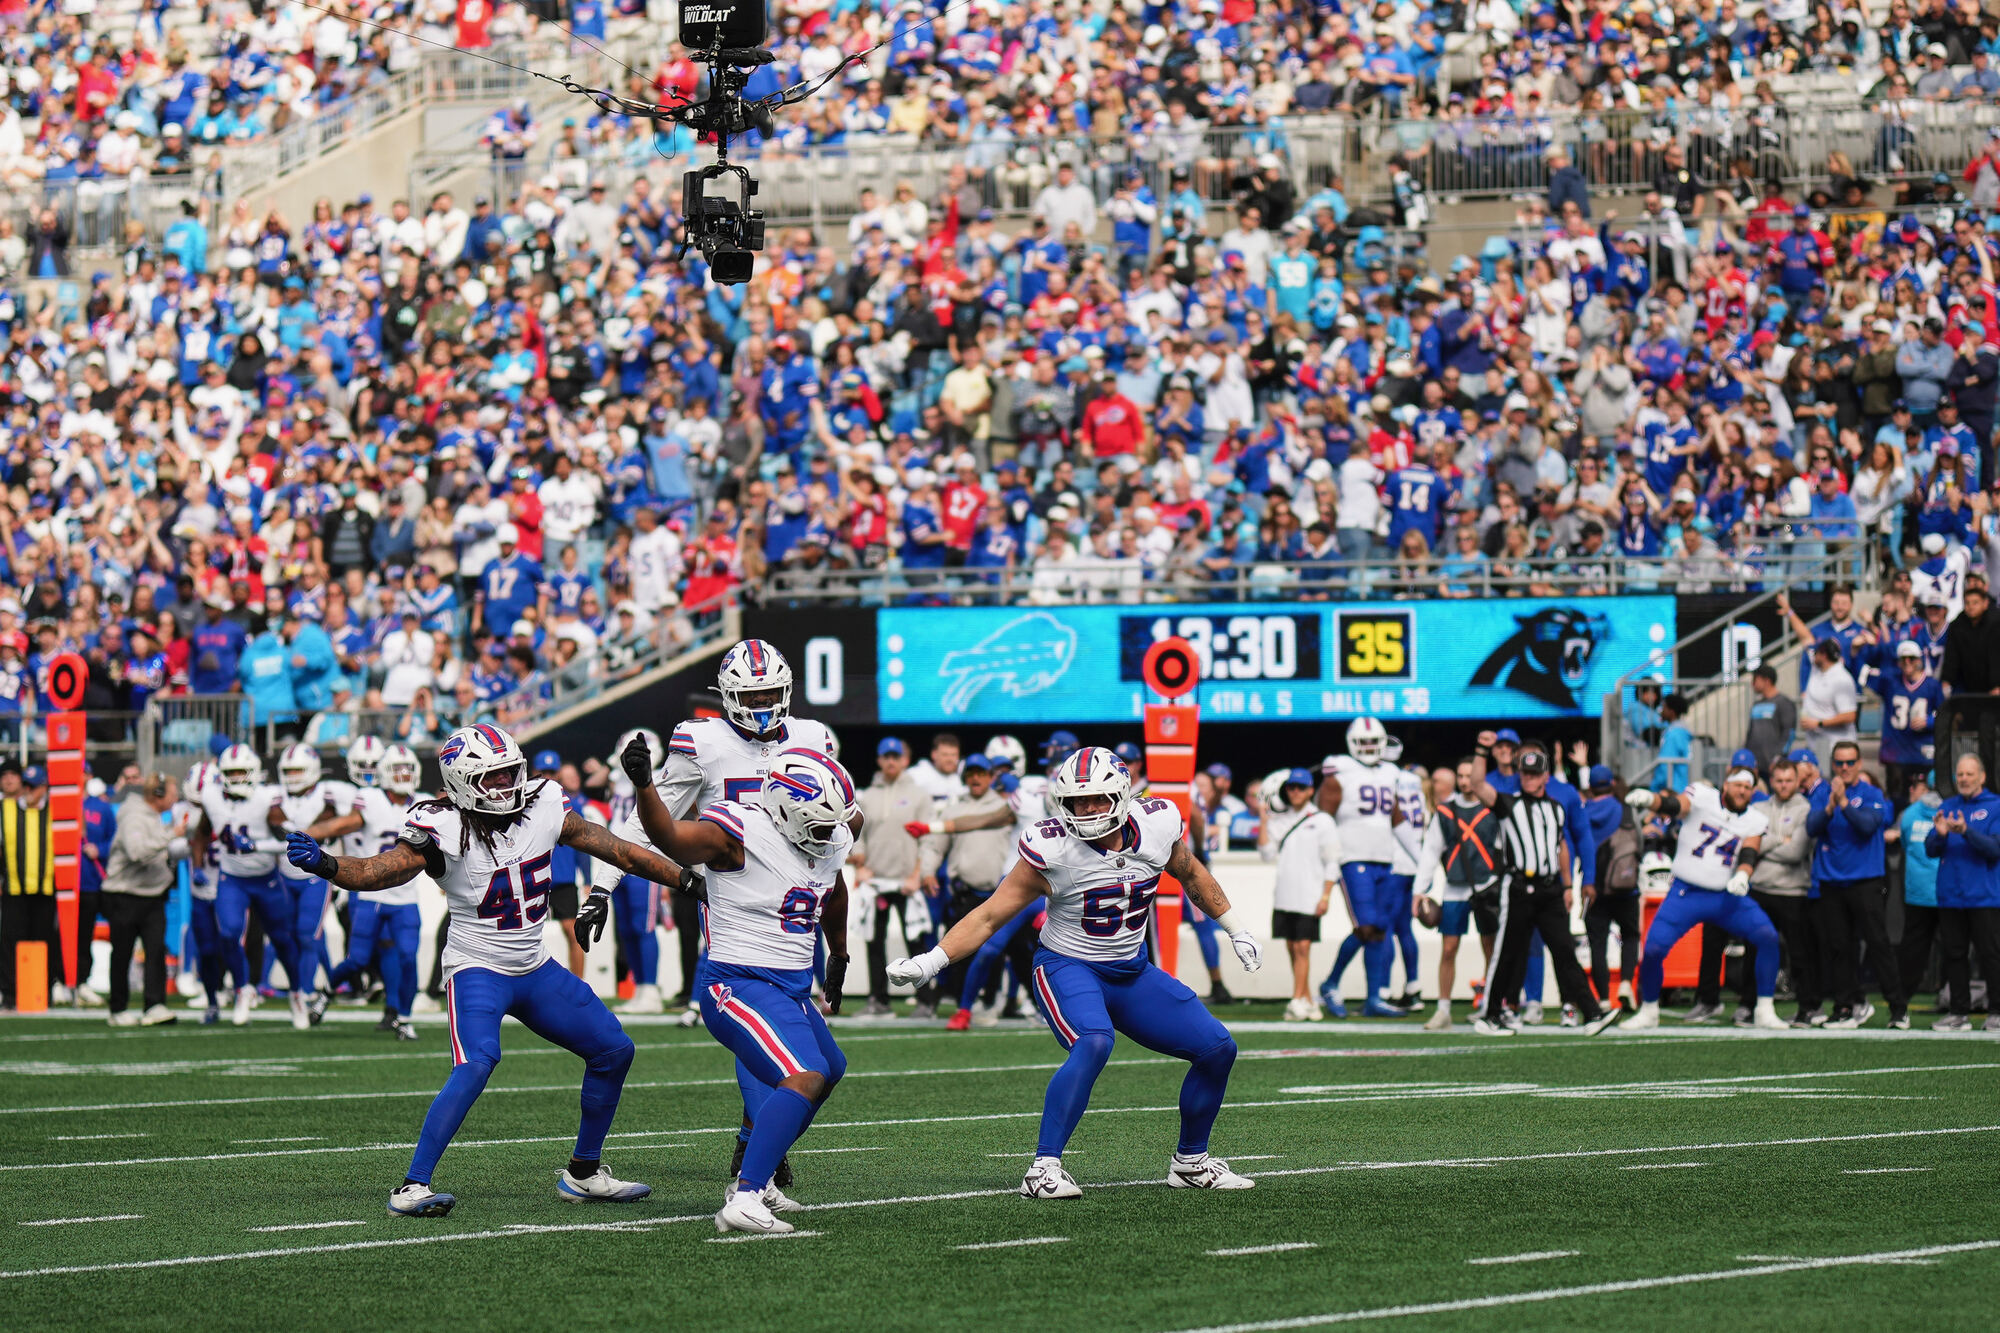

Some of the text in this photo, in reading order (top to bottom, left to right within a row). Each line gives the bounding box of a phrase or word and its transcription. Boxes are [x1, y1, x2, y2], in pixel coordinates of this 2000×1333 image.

[684, 10, 731, 24] WILDCAT
[1398, 482, 1429, 512] 14
[488, 568, 519, 600] 17
[1348, 622, 1404, 673] 35
[805, 637, 842, 705] 0
[1210, 691, 1244, 714] 4TH
[1322, 690, 1365, 713] BALL
[1370, 690, 1395, 713] ON
[1890, 695, 1928, 731] 34
[1358, 785, 1393, 816] 96
[1692, 823, 1740, 867] 74
[477, 849, 552, 931] 45
[1116, 874, 1136, 883] BILLS
[1081, 872, 1162, 937] 55
